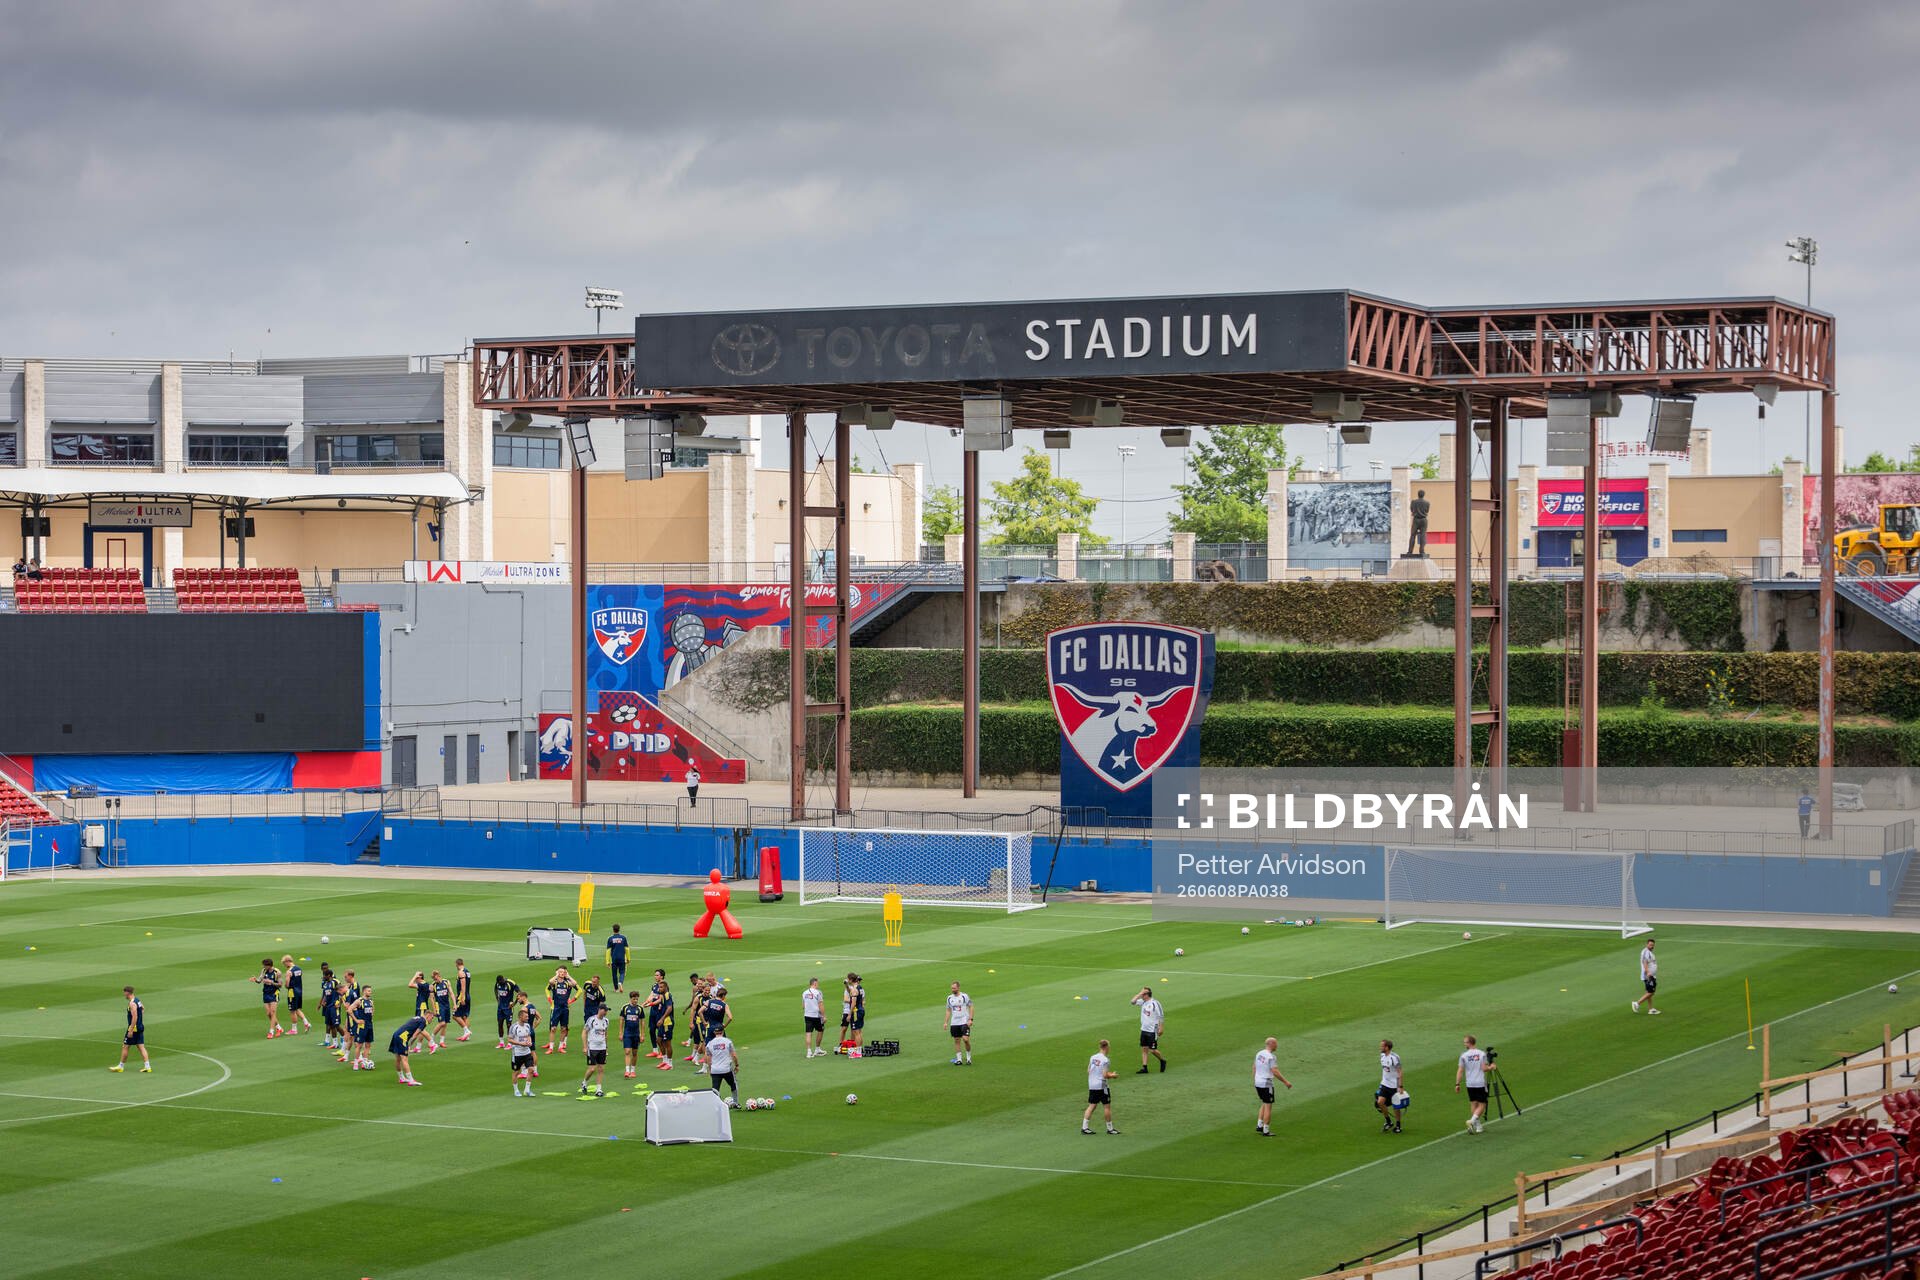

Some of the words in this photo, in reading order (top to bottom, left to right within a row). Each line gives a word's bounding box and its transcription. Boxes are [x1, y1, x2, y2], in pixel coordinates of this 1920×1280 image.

[795, 323, 996, 369] TOYOTA
[1025, 313, 1257, 361] STADIUM
[145, 507, 182, 516] ULTRA
[509, 566, 533, 577] ULTRA
[536, 567, 560, 577] ZONE
[596, 612, 608, 627] FC
[611, 611, 643, 626] DALLAS
[1060, 637, 1087, 675] FC
[1099, 634, 1187, 676] DALLAS
[1109, 678, 1137, 687] 96
[609, 730, 671, 753] DTID
